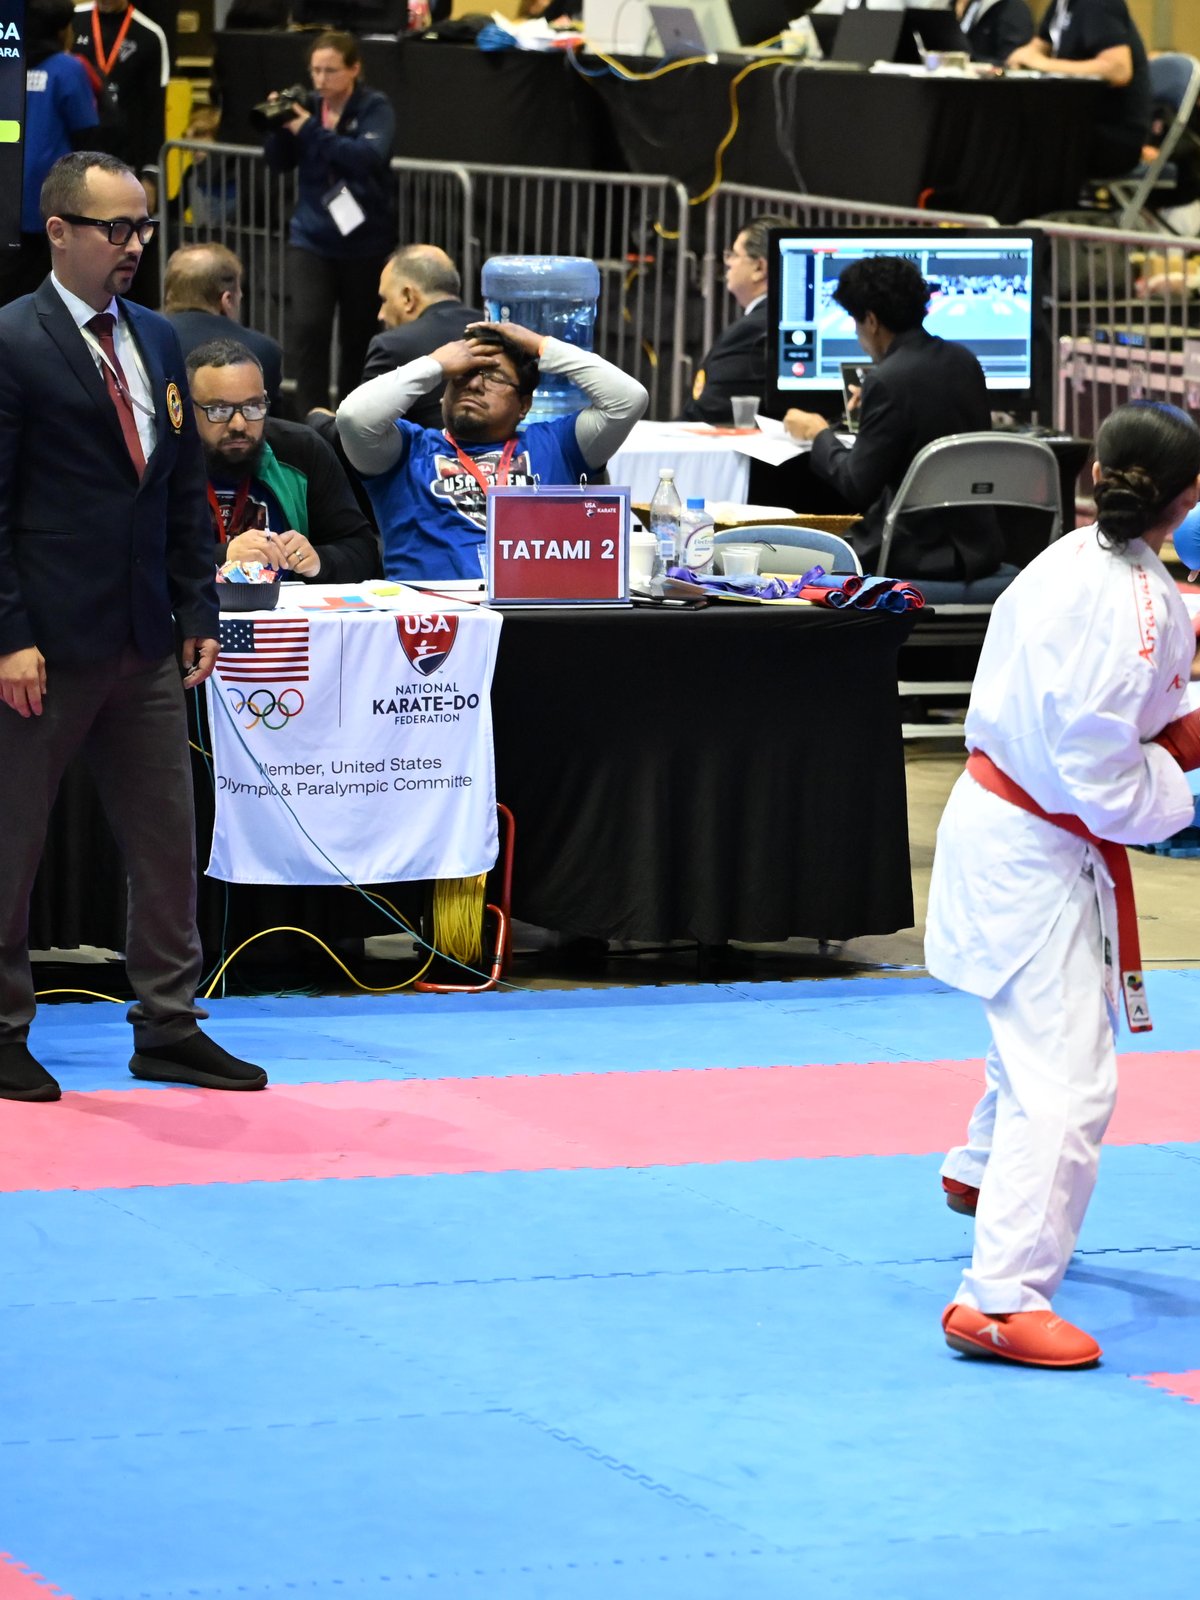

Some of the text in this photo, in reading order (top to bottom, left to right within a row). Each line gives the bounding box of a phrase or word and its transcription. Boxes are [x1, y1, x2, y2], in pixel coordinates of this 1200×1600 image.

[443, 474, 476, 493] USA
[498, 539, 615, 560] TATAMI 2
[403, 614, 451, 635] USA
[395, 682, 459, 696] NATIONAL
[372, 693, 480, 715] KARATE-DO
[394, 713, 460, 726] FEDERATION
[331, 757, 385, 775] United
[390, 757, 442, 772] States
[281, 782, 293, 797] &
[297, 779, 389, 798] Paralympic
